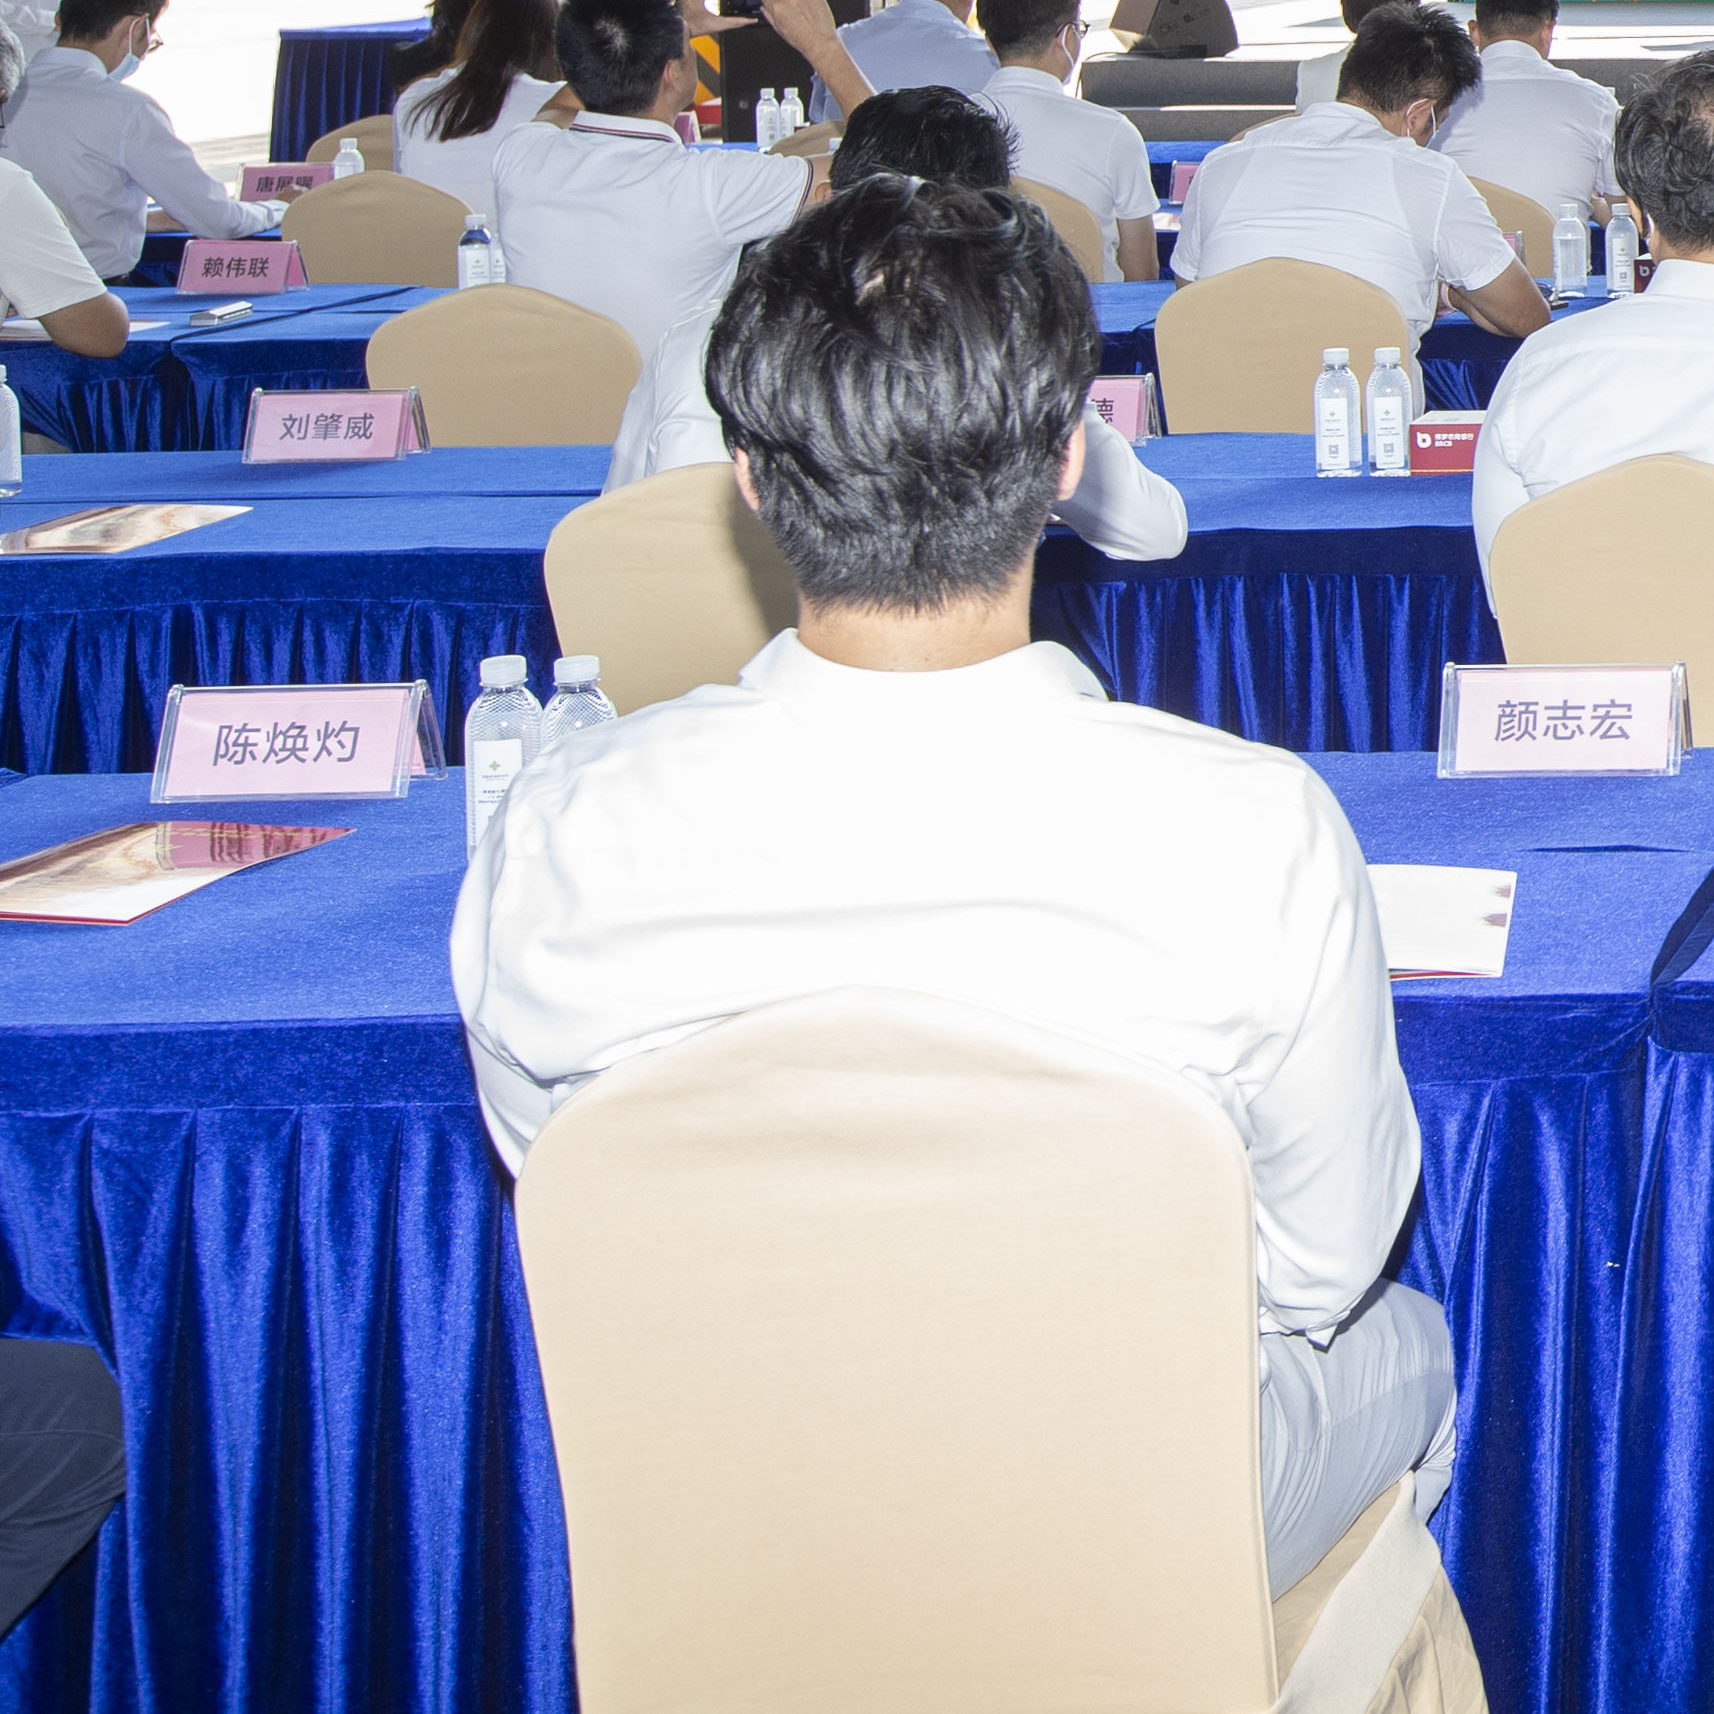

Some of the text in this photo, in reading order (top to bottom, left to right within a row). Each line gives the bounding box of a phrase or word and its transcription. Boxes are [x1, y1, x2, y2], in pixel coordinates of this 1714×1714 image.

[201, 256, 270, 278] 赖伟联
[278, 411, 375, 443] 刘肇威
[1493, 697, 1634, 745] 颜志宏
[212, 721, 361, 766] 陈焕灼
